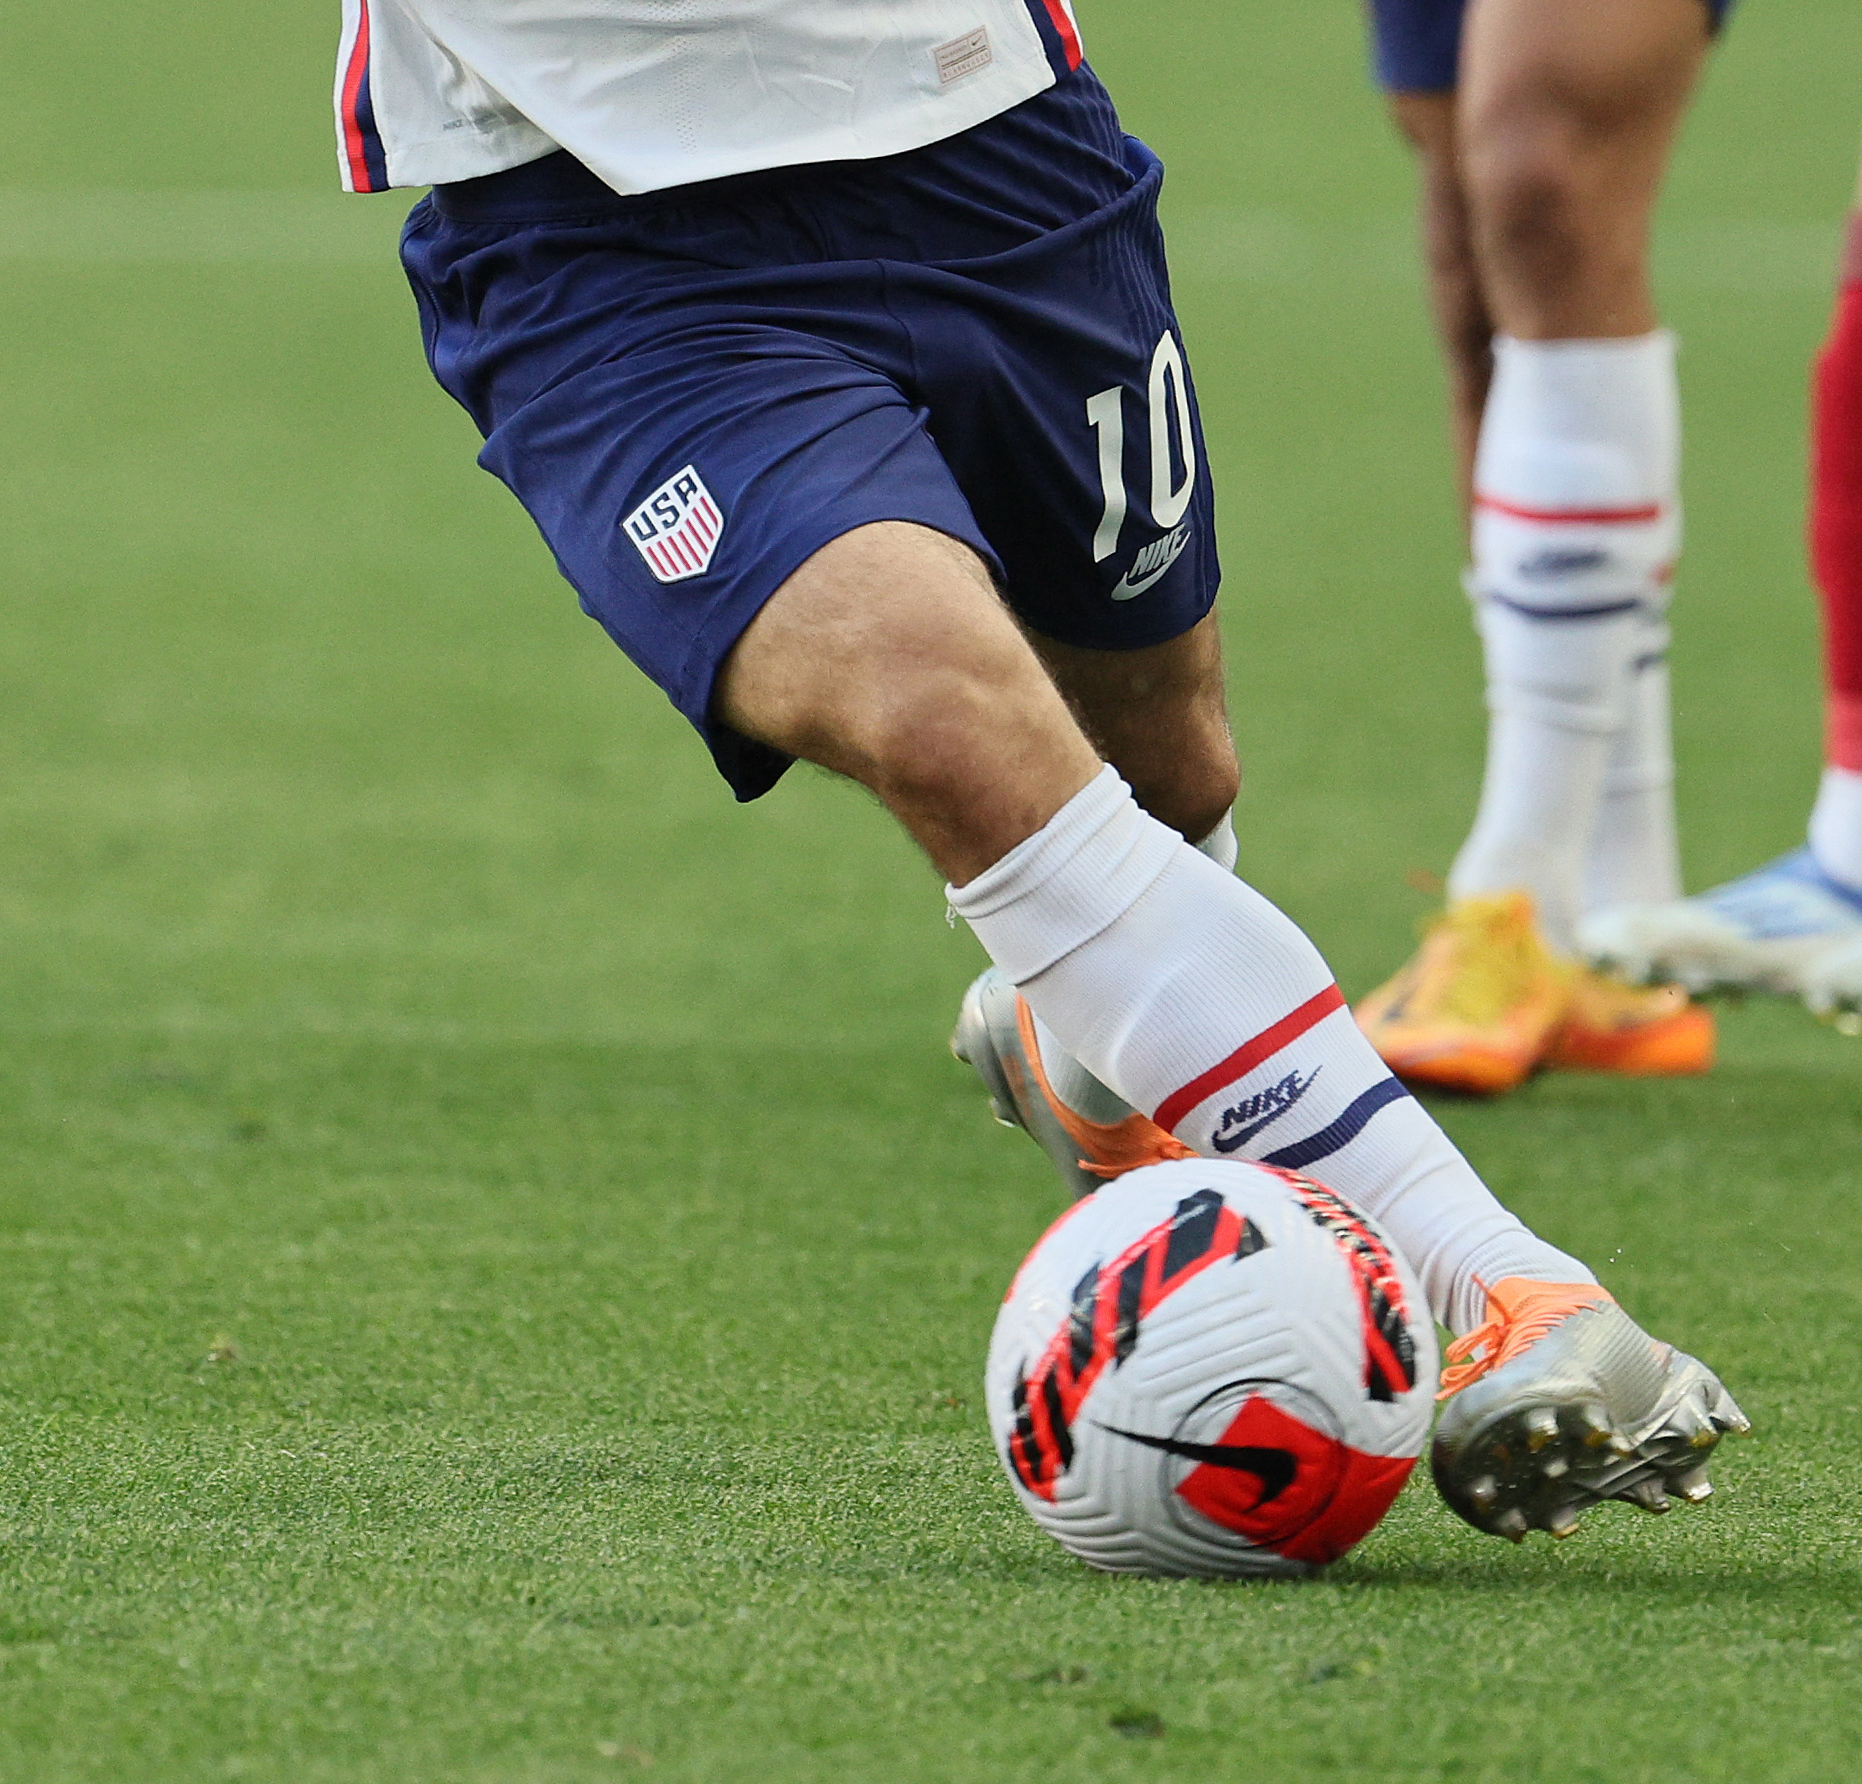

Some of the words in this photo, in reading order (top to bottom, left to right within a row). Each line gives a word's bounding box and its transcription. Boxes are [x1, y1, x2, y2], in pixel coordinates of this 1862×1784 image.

[1085, 328, 1196, 564] 10
[630, 472, 700, 542] USA
[1127, 521, 1187, 580] NIKE
[1221, 1068, 1304, 1133] NIKE
